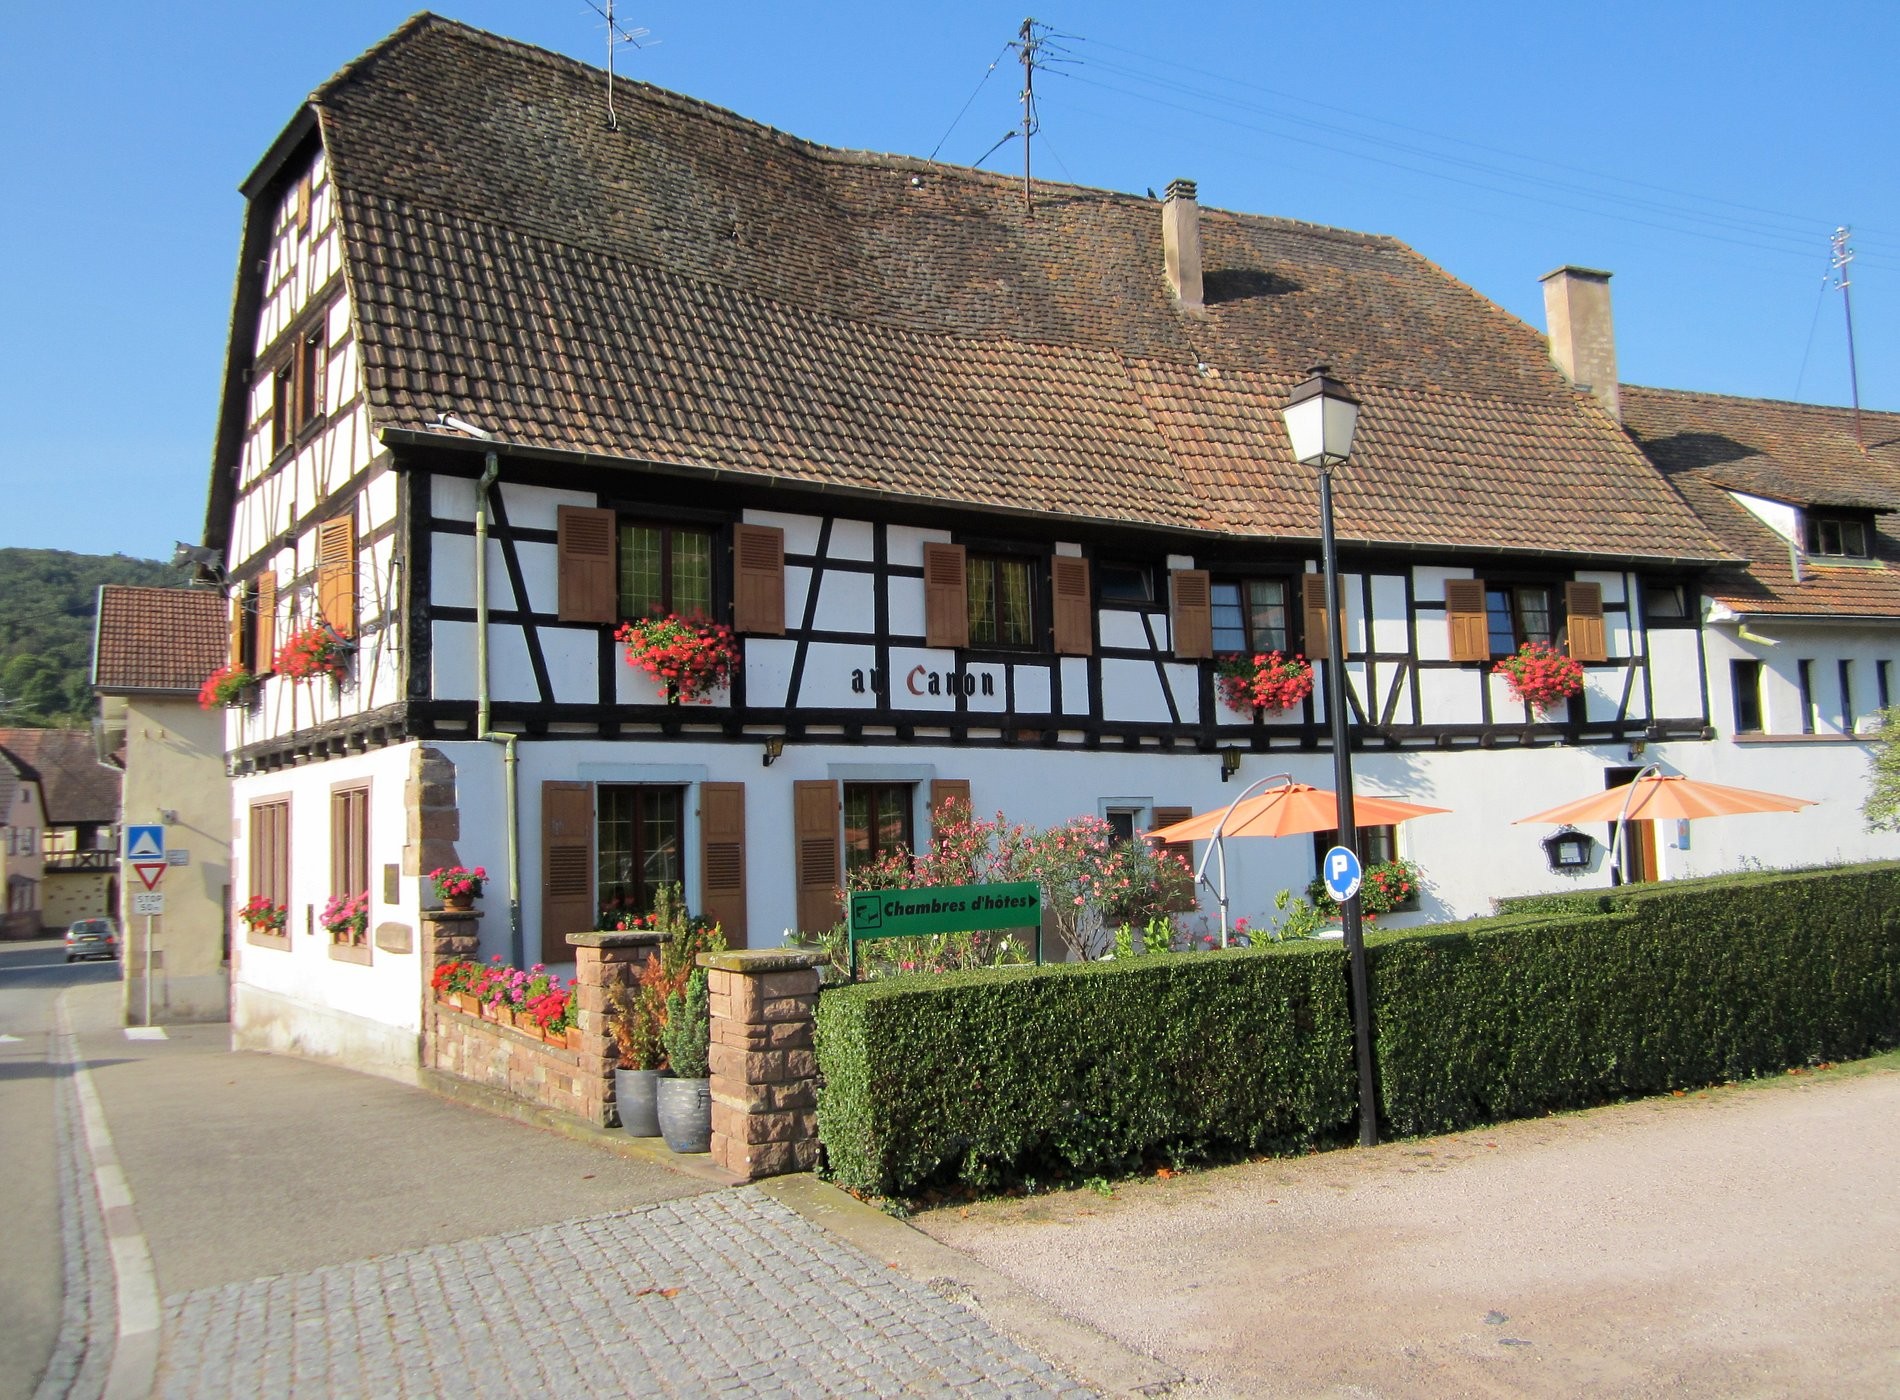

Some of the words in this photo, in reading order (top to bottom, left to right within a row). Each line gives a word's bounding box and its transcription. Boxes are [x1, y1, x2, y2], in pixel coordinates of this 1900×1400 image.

[851, 667, 882, 695] au
[906, 664, 994, 696] Canon
[1332, 855, 1347, 880] P
[884, 899, 966, 917] Chambres
[971, 895, 1027, 911] d'hôtes
